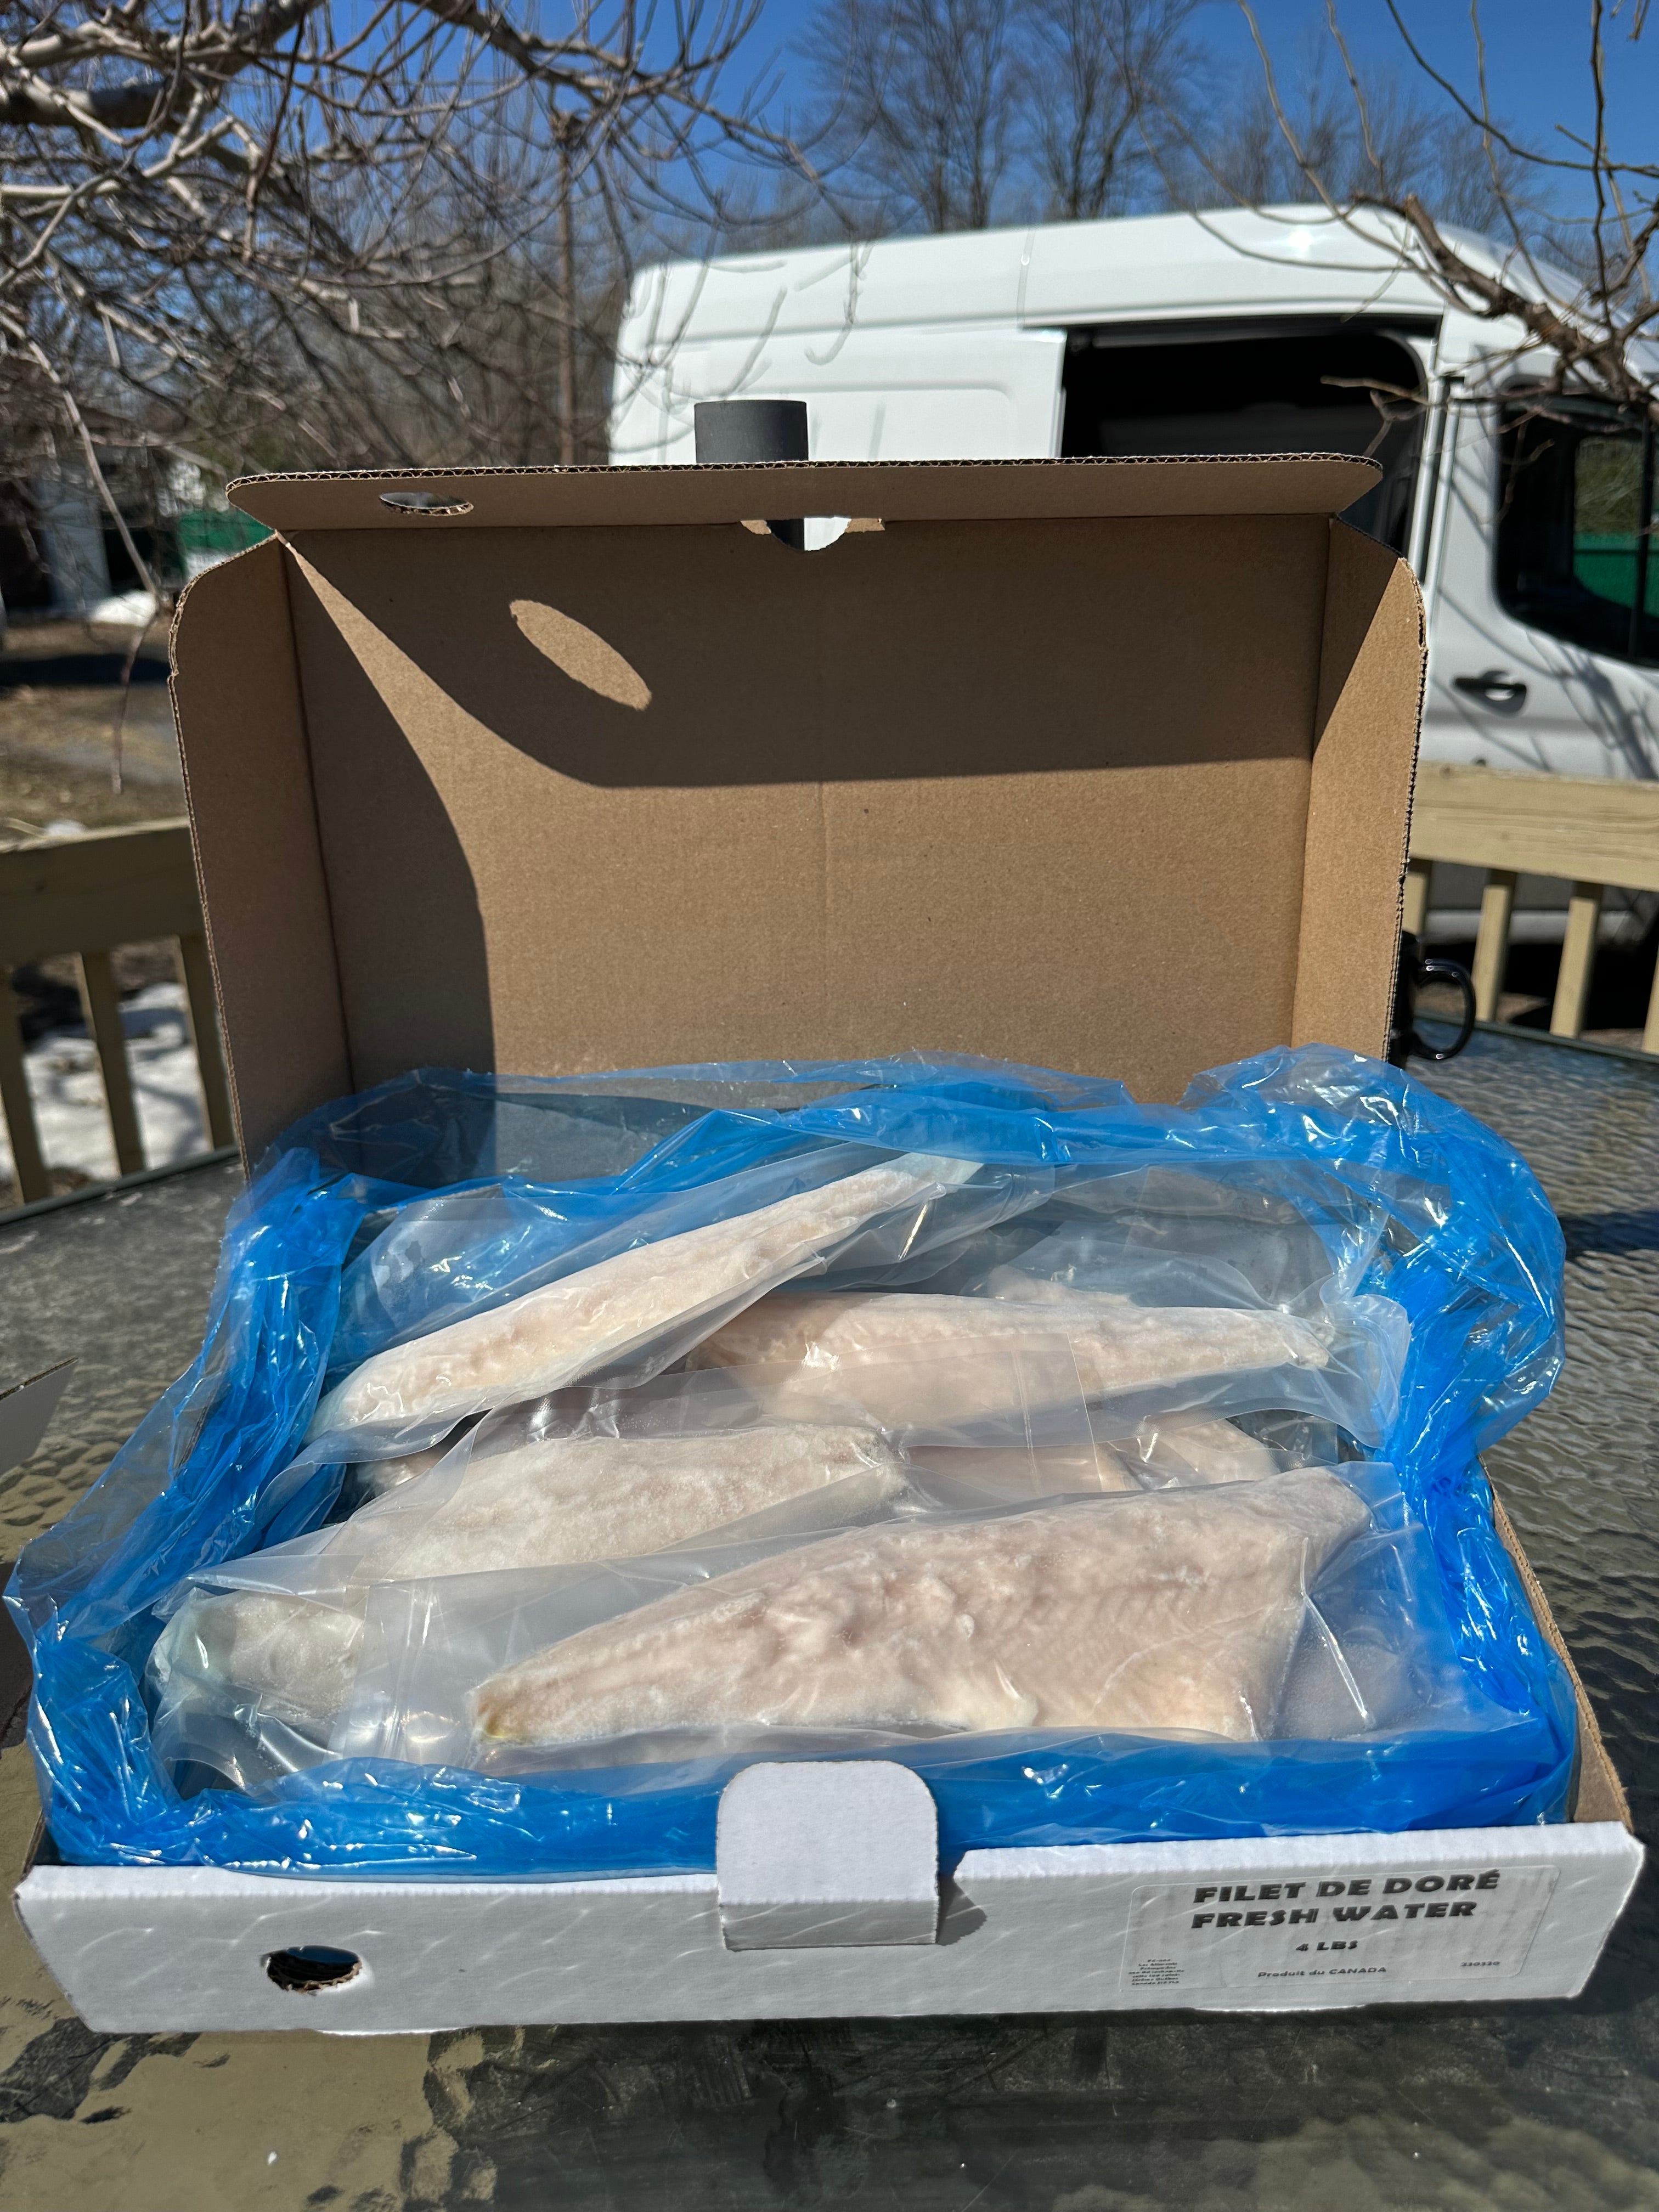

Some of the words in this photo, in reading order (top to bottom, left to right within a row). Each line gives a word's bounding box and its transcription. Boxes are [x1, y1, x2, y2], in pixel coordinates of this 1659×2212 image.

[1193, 1882, 1306, 1903] FILET
[1316, 1879, 1372, 1897] DE
[1383, 1869, 1500, 1894] DORÉ
[1191, 1908, 1319, 1928] FRESH
[1333, 1901, 1477, 1921] WATER
[1317, 1940, 1358, 1950] LBS
